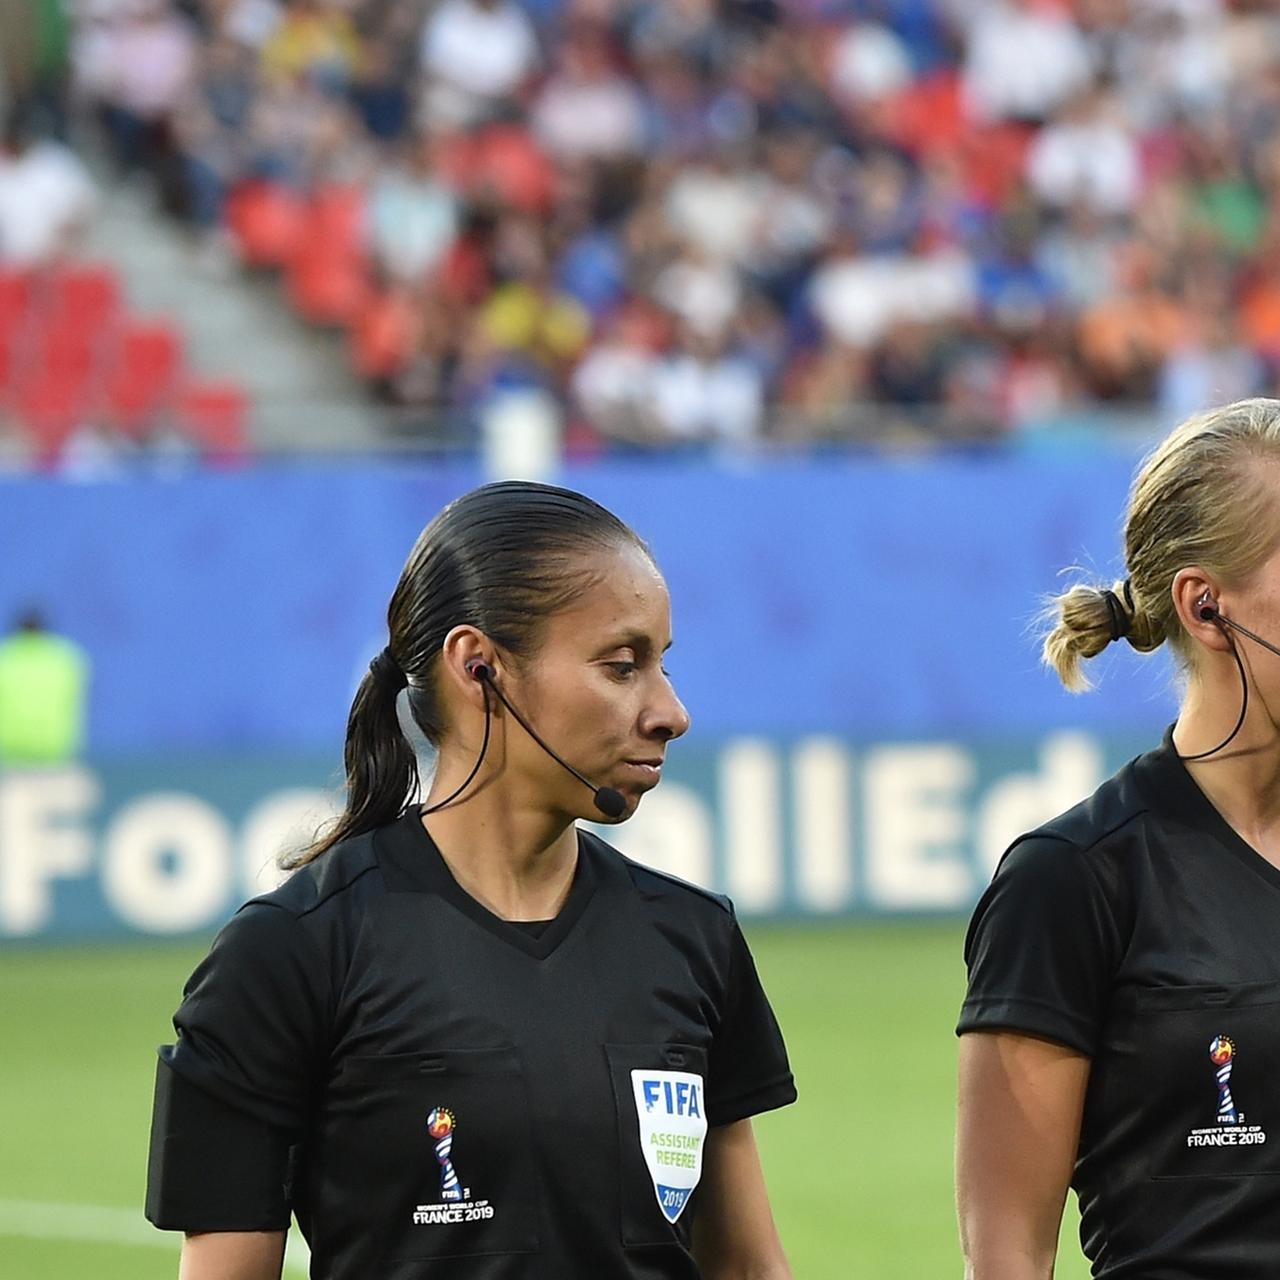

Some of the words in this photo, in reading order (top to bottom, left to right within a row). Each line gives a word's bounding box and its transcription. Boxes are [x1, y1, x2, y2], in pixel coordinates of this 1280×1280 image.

[642, 1081, 701, 1119] FIFA
[650, 1132, 700, 1151] ASSISTANT
[1187, 1133, 1238, 1147] FRANCE
[1238, 1132, 1266, 1145] 2019
[656, 1150, 696, 1169] REFEREE
[662, 1189, 685, 1209] 2019
[413, 1209, 464, 1224] FRANCE
[465, 1206, 494, 1221] 2019
